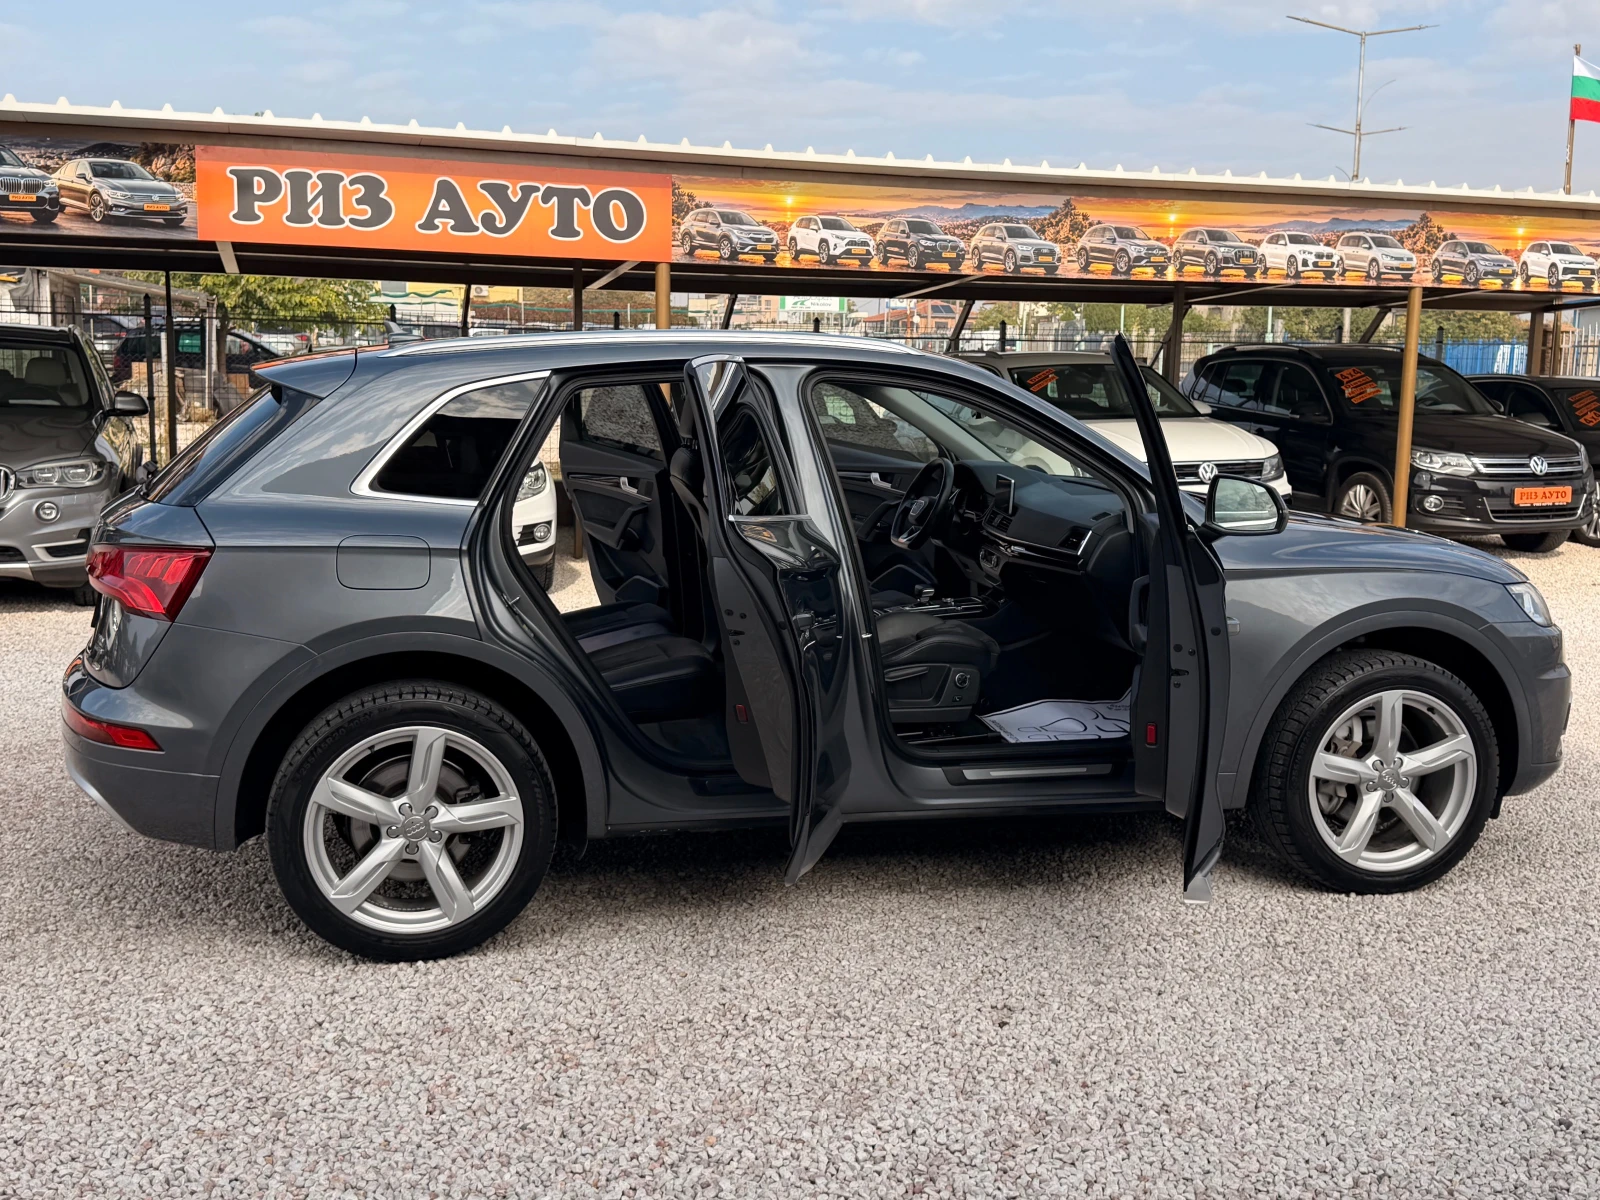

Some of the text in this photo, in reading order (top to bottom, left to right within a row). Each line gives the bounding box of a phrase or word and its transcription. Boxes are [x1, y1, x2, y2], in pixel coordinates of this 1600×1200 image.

[227, 166, 647, 244] РИЗ АУТО
[1520, 490, 1567, 500] РИЗ АУТО
